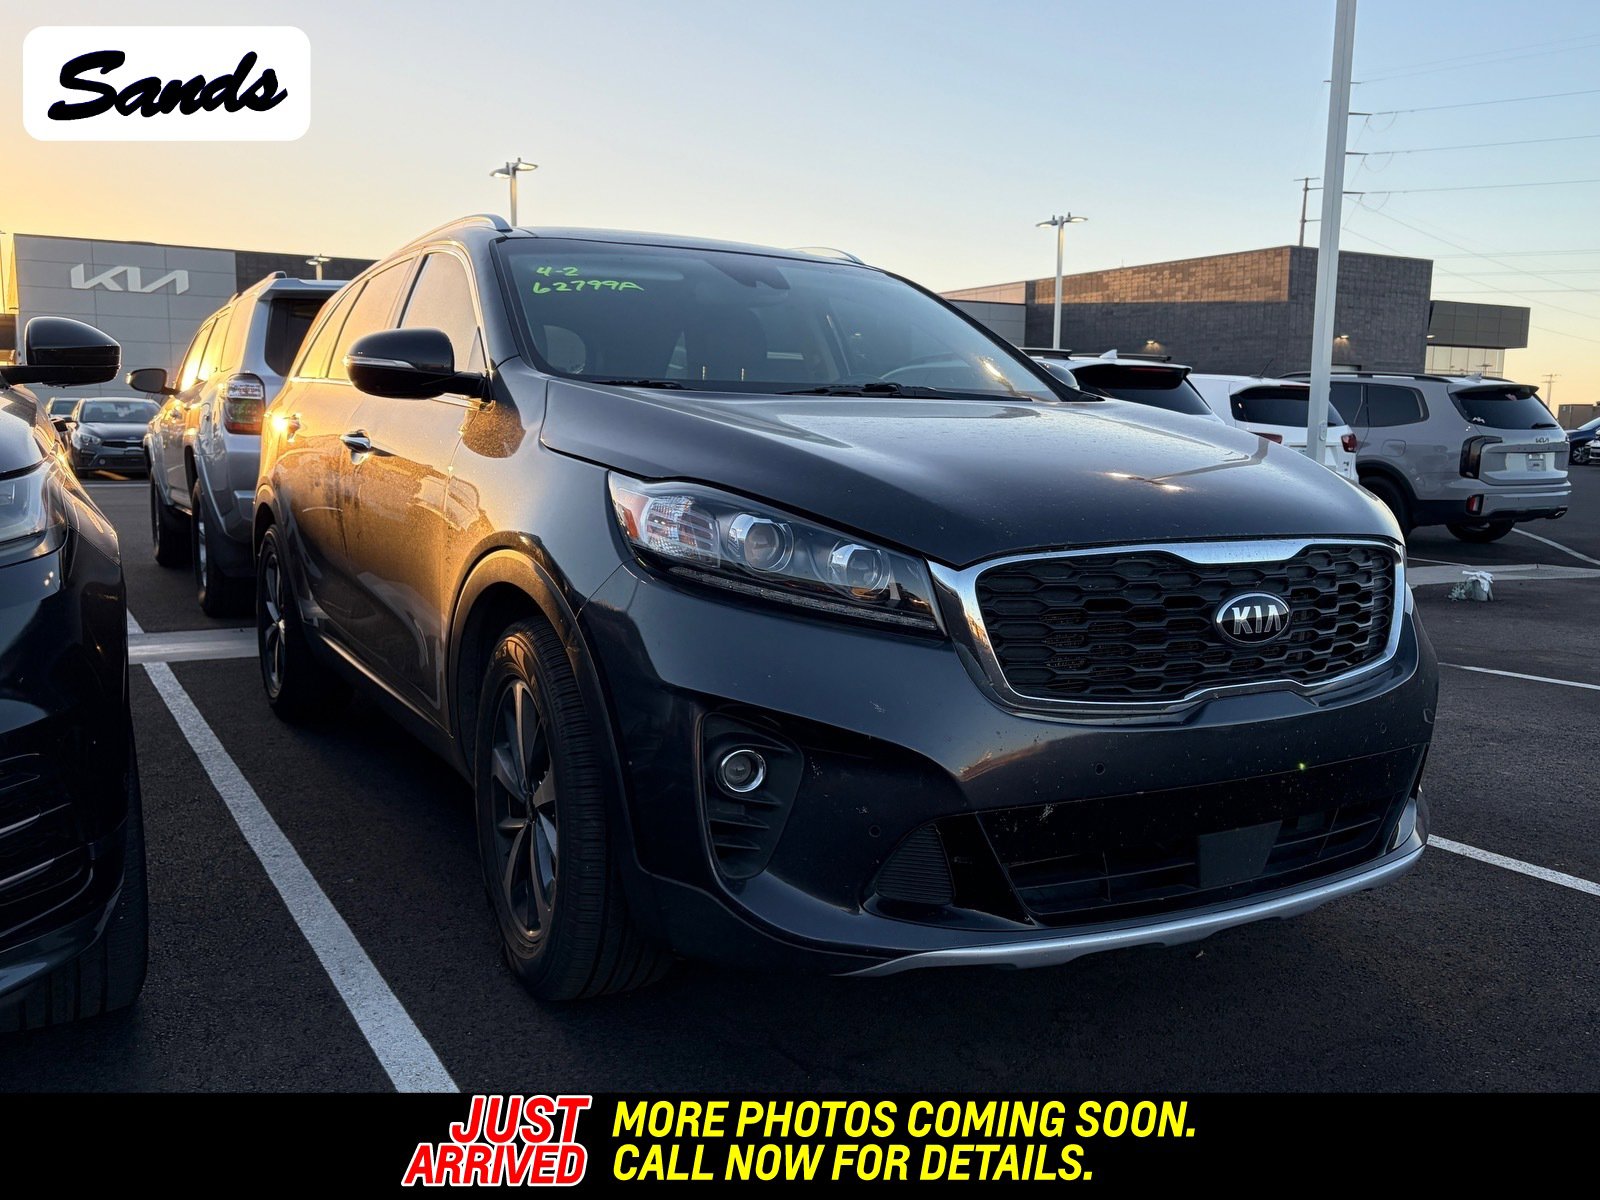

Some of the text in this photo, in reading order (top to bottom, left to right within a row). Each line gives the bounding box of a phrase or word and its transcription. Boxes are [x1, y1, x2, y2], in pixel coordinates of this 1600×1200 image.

[536, 266, 579, 277] 4-2
[532, 280, 645, 294] 62799A
[1231, 604, 1282, 635] KIA
